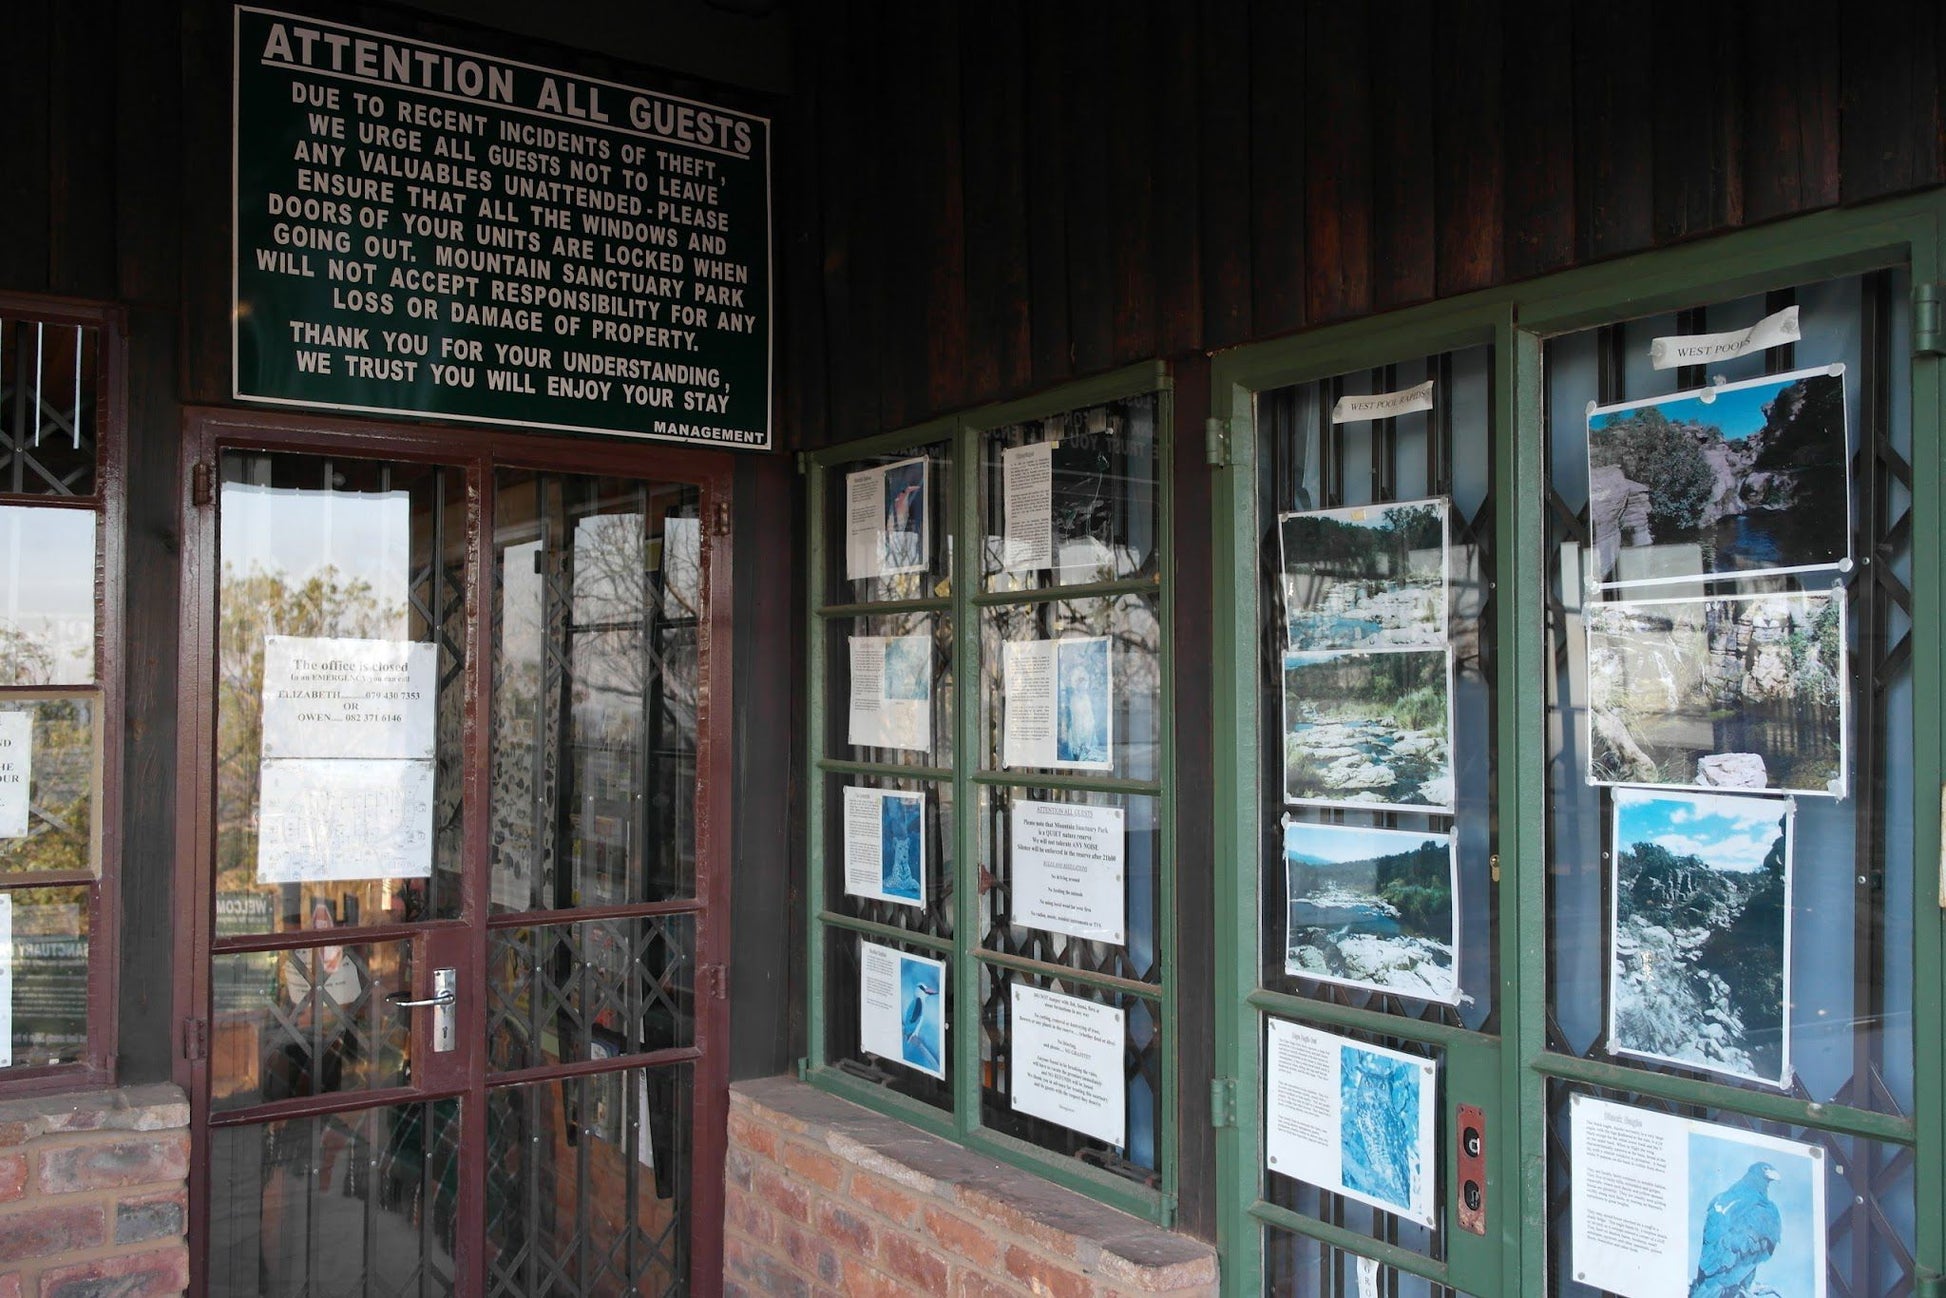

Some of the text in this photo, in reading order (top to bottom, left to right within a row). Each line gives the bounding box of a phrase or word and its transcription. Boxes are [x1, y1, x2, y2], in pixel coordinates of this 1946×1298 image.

[263, 23, 751, 153] ATTENTION ALL GUESTS
[292, 81, 339, 110] DUE
[353, 92, 384, 117] TO
[398, 100, 487, 136] RECENT
[500, 120, 610, 159] INCIDENTS
[621, 144, 645, 165] OF
[294, 139, 346, 167] ANY
[359, 149, 492, 191] VALUABLES
[308, 112, 717, 205] WE URGE ALL GUESTS NOT TO LEAVE
[269, 192, 747, 284] DOORS OF YOUR UNITS ARE LOCKED WHEN
[298, 168, 726, 255] ENSURE THAT ALL THE WINDOWS AND
[256, 248, 755, 334] WILL NOT ACCEPT RESPONSIBILITY FOR ANY
[273, 222, 744, 308] GOING OUT. MOUNTAIN SANCTUARY PARK
[289, 320, 369, 350] THANK
[381, 330, 428, 356] YOU
[441, 337, 483, 362] FOR
[494, 343, 552, 369] YOUR
[333, 287, 698, 351] LOSS OR DAMAGE OF PROPERTY.
[296, 349, 729, 414] WE TRUST YOU WILL ENJOY YOUR STAY
[1678, 346, 1712, 358] WEST
[653, 420, 765, 444] MANAGEMENT
[1350, 402, 1374, 411] WEST
[293, 659, 318, 670] The
[322, 659, 355, 671] office
[372, 661, 408, 673] closed
[401, 692, 420, 700] 7353
